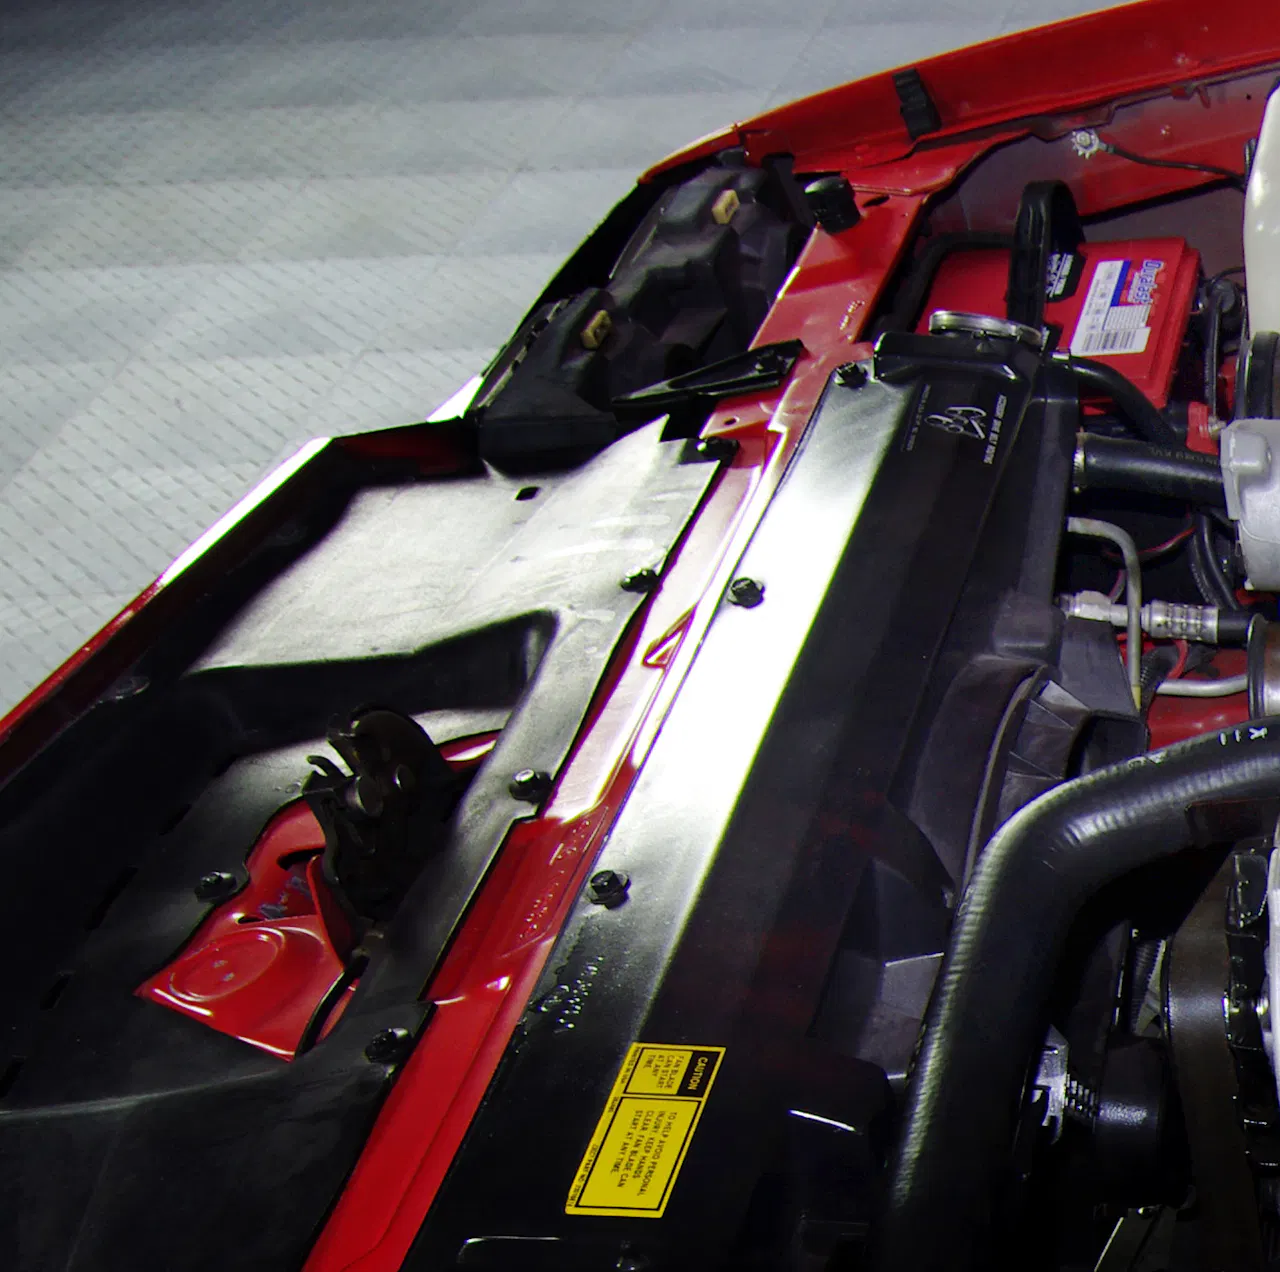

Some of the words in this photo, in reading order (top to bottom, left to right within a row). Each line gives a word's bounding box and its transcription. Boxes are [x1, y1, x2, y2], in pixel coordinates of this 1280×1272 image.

[1134, 260, 1163, 305] Duralast
[655, 1055, 665, 1063] AT
[662, 1055, 674, 1068] CAN
[672, 1056, 684, 1068] FAN
[651, 1064, 661, 1077] ANY
[656, 1069, 670, 1088] START
[664, 1069, 680, 1089] BLADE
[687, 1057, 708, 1090] CAUTION
[629, 1110, 643, 1130] START
[667, 1112, 677, 1120] TO
[625, 1131, 635, 1140] AT
[661, 1121, 673, 1138] HELP
[617, 1142, 630, 1156] ANY
[632, 1134, 645, 1148] FAN
[643, 1137, 656, 1154] KEEP
[651, 1140, 667, 1160] AVOID
[621, 1150, 638, 1172] BLADE
[632, 1155, 648, 1179] HANDS
[616, 1173, 629, 1188] CAN
[637, 1161, 659, 1196] PERSONAL
